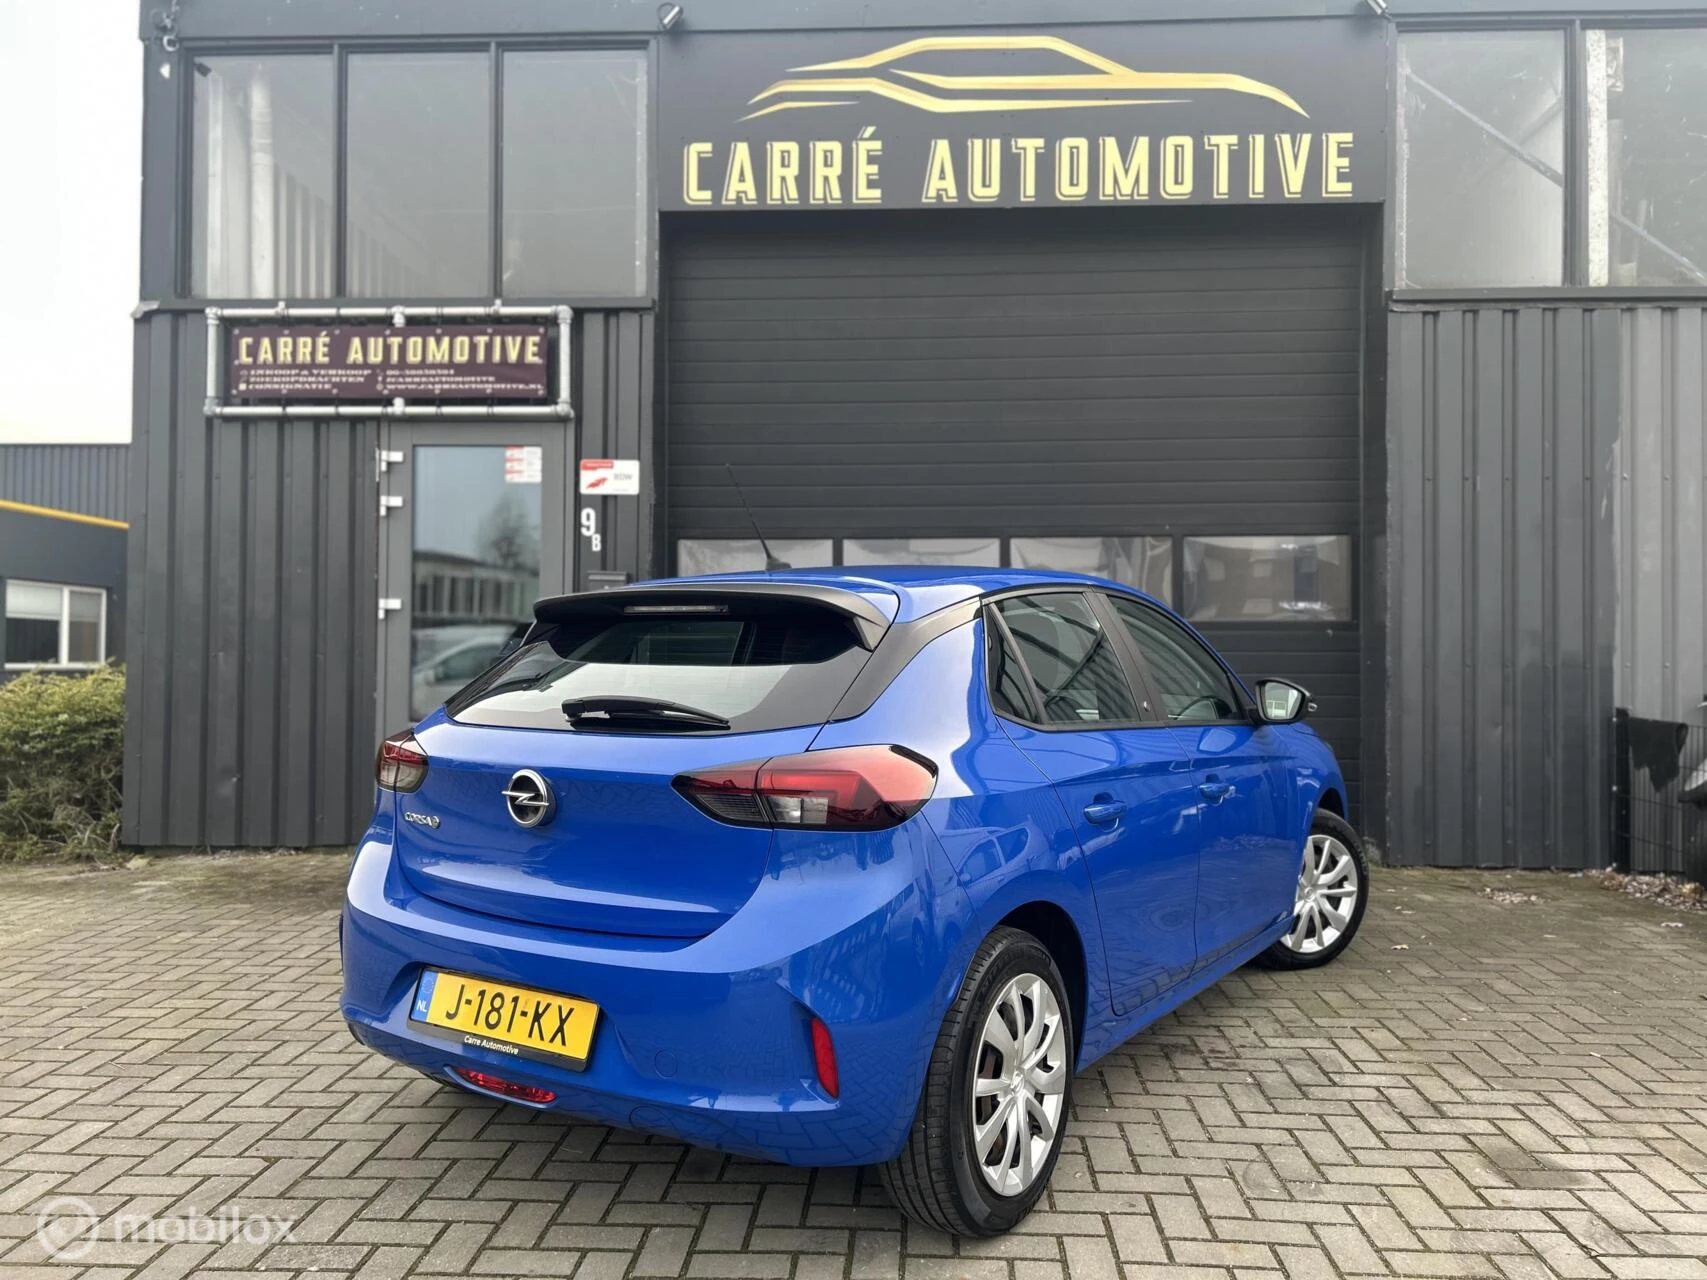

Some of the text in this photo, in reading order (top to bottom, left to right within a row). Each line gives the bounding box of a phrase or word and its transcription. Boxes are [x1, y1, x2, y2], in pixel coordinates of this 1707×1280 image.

[682, 126, 1354, 205] CARRÉ AUTOMOTIVE
[238, 331, 542, 365] CARRÉ AUTOMOTIVE
[416, 1000, 428, 1013] NL
[445, 984, 575, 1047] J-181-KX
[463, 1035, 520, 1056] Carre Automotive
